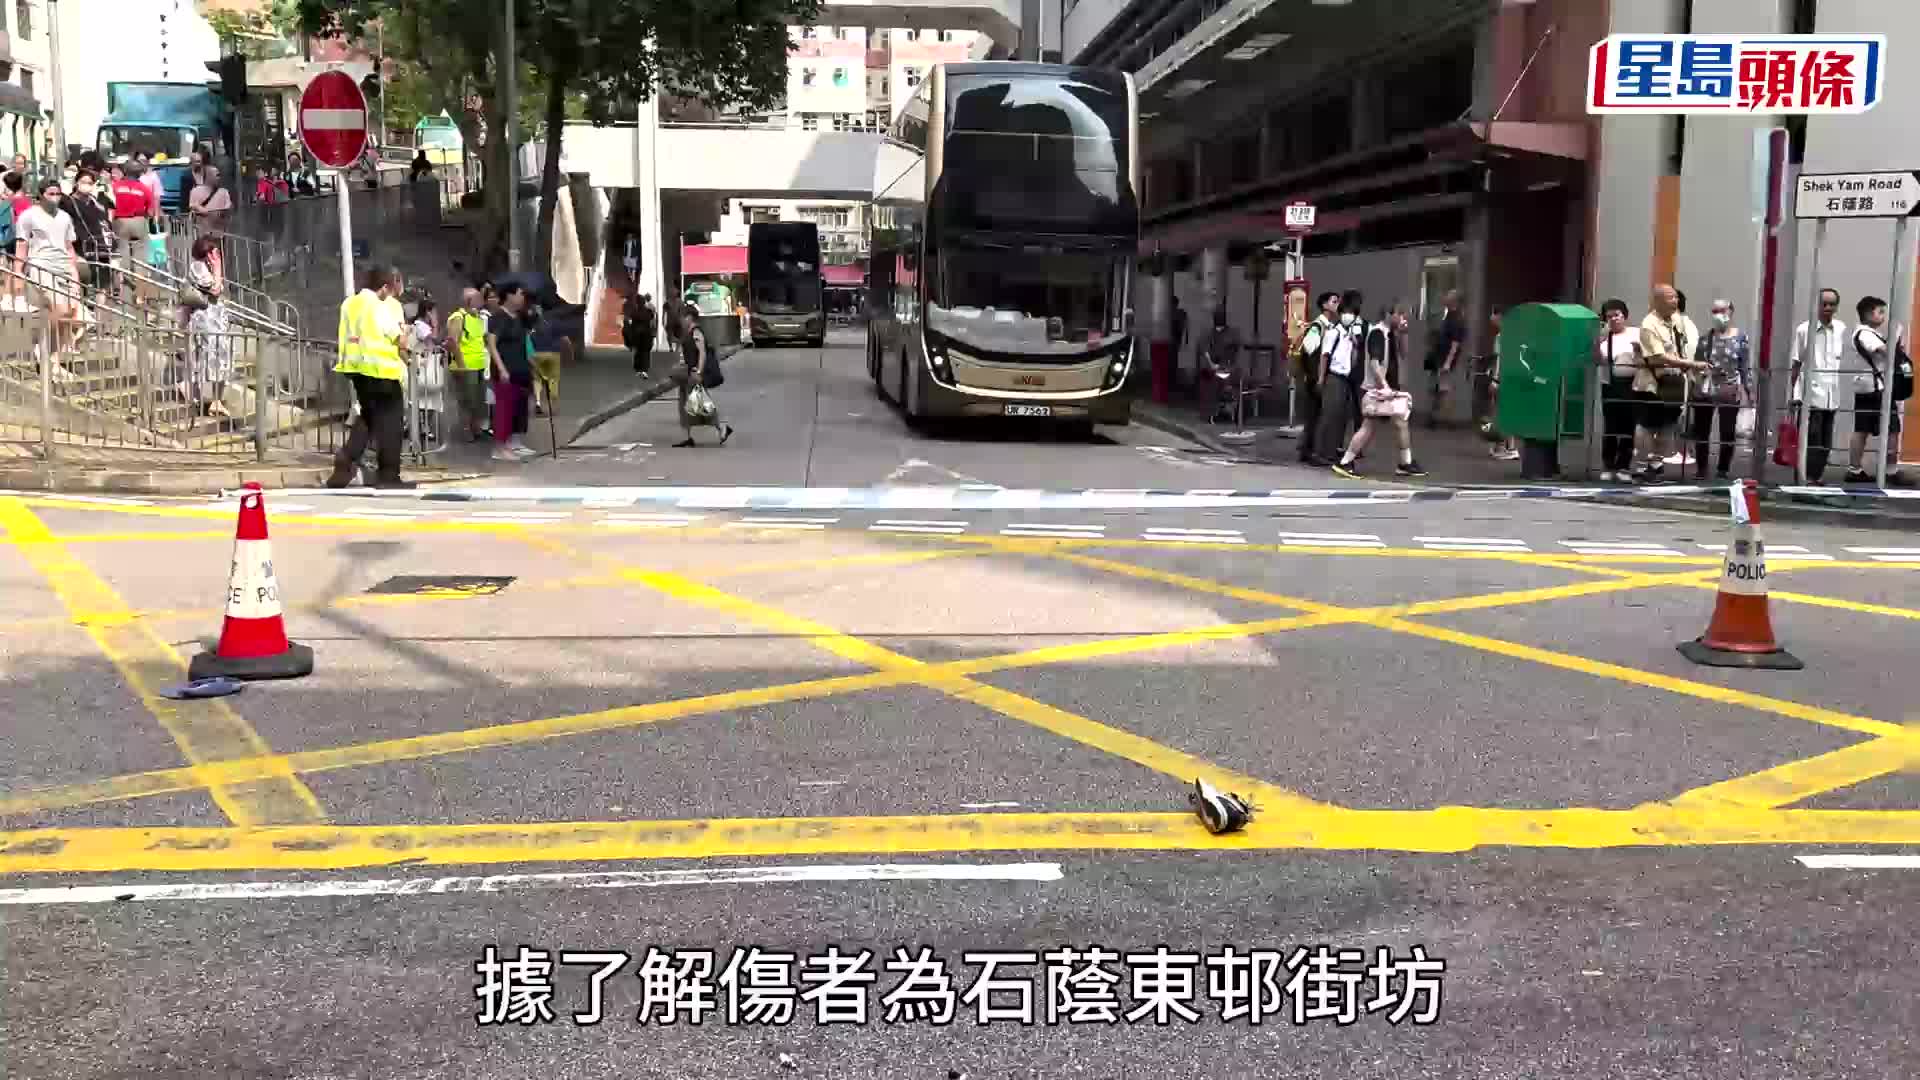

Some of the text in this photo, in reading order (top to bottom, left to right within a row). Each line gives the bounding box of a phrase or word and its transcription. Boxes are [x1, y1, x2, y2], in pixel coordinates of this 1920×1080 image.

[1803, 178, 1902, 192] Shek Yam Road
